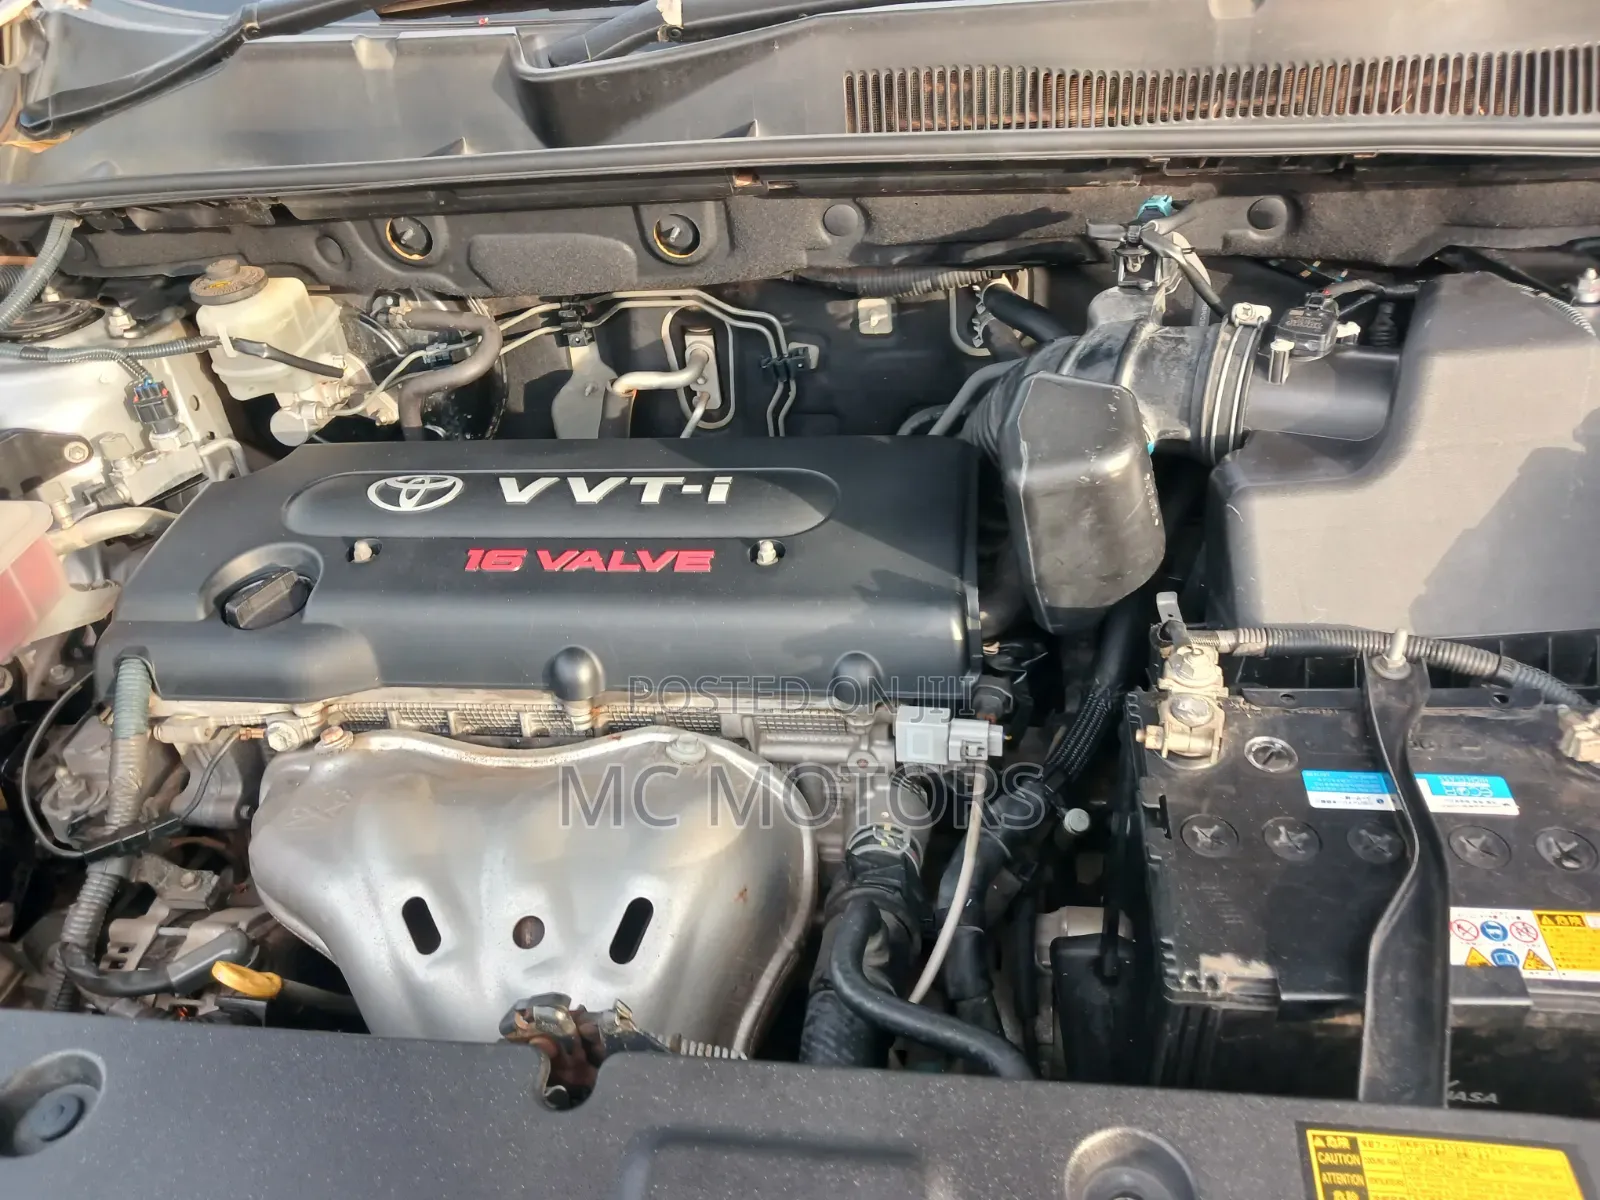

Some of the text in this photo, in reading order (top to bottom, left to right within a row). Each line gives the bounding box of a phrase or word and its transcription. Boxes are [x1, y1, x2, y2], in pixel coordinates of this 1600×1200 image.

[499, 476, 733, 505] VVT-i
[464, 548, 715, 573] 16 VALVE
[1317, 1151, 1361, 1166] CAUTION
[1321, 1171, 1365, 1187] ATTENTION
